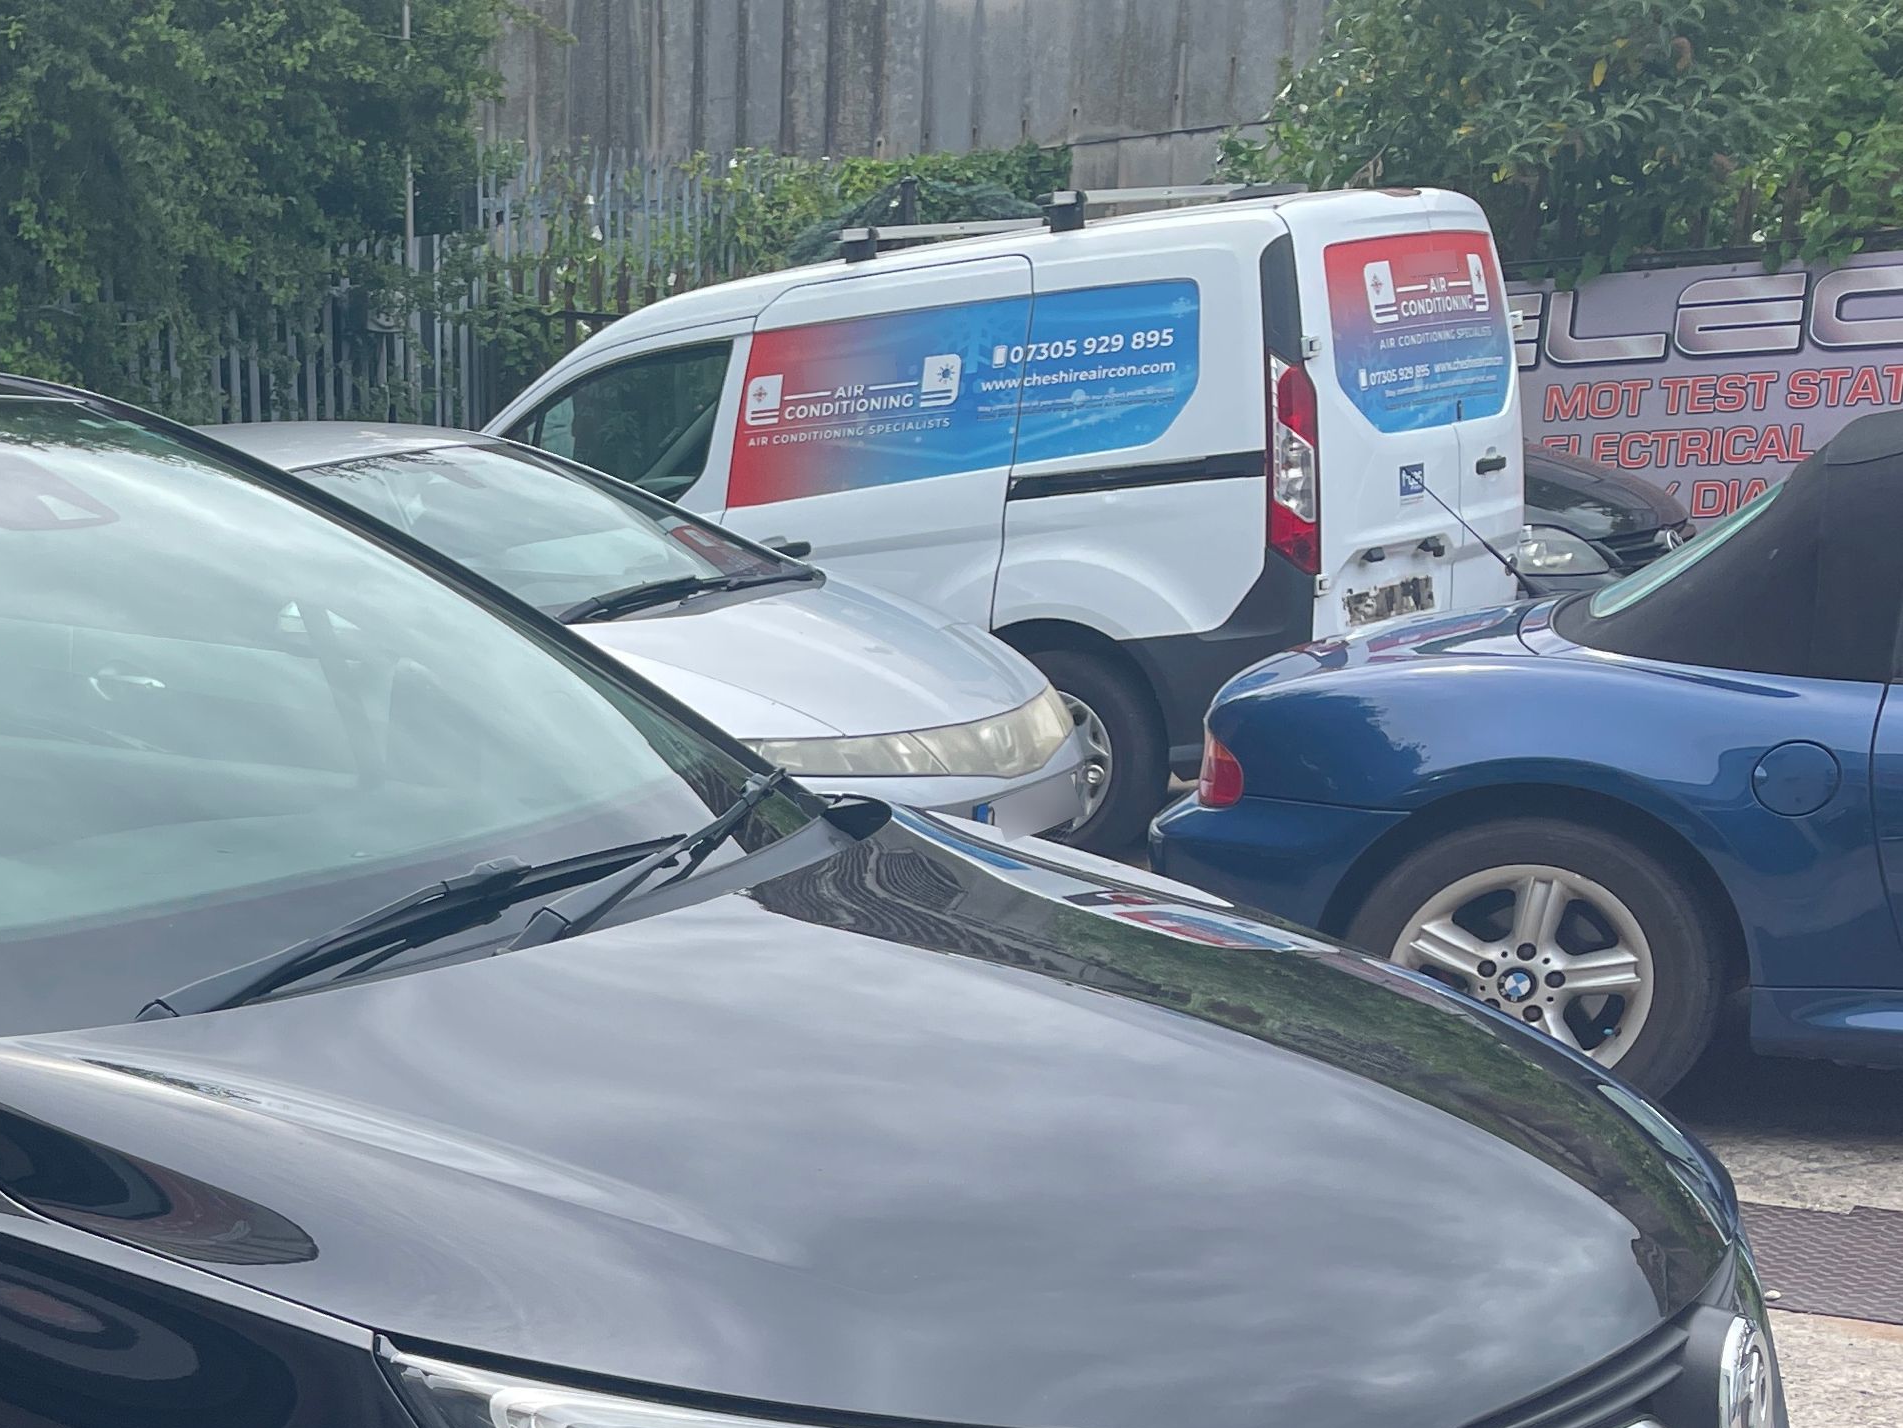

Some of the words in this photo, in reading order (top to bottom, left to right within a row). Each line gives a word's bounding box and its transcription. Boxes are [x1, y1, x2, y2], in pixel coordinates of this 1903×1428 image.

[1429, 277, 1448, 294] AIR
[1401, 294, 1474, 317] CONDITIONING
[1010, 339, 1077, 364] 07305
[1083, 334, 1124, 356] 929
[1131, 328, 1175, 350] 895
[1379, 338, 1396, 350] AIR
[1398, 329, 1455, 347] CONDITIONING
[981, 361, 1176, 392] www.cheshireaircon.com
[1369, 369, 1398, 386] 07305
[1398, 365, 1414, 380] 929
[1415, 364, 1431, 379] 895
[833, 384, 865, 400] AIR
[1543, 379, 1652, 421] MOT
[1661, 372, 1779, 415] TEST
[784, 393, 915, 421] CONDITIONING
[748, 437, 769, 448] AIR
[772, 426, 865, 445] CONDITIONING
[869, 417, 951, 436] SPECIALISTS
